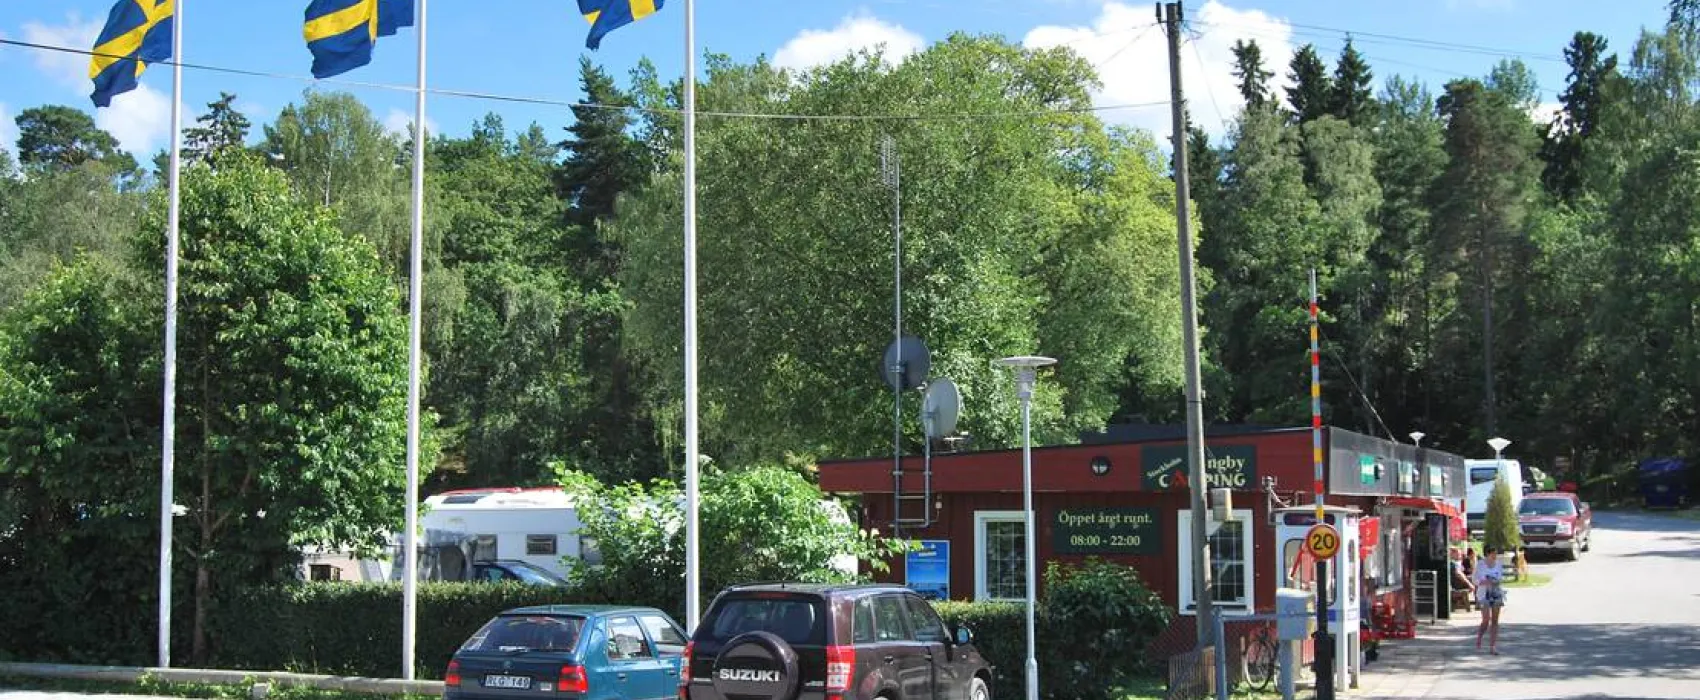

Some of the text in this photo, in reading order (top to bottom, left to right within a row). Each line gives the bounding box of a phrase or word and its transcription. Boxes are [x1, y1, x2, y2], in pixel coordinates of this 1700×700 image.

[1203, 455, 1246, 474] ngby
[1158, 469, 1247, 488] CAPING
[1058, 510, 1095, 527] Öppet
[1070, 535, 1101, 546] 08:00
[1110, 535, 1141, 546] 22:00
[1313, 533, 1335, 550] 20
[512, 677, 530, 689] 149
[719, 668, 780, 682] SUZUKI
